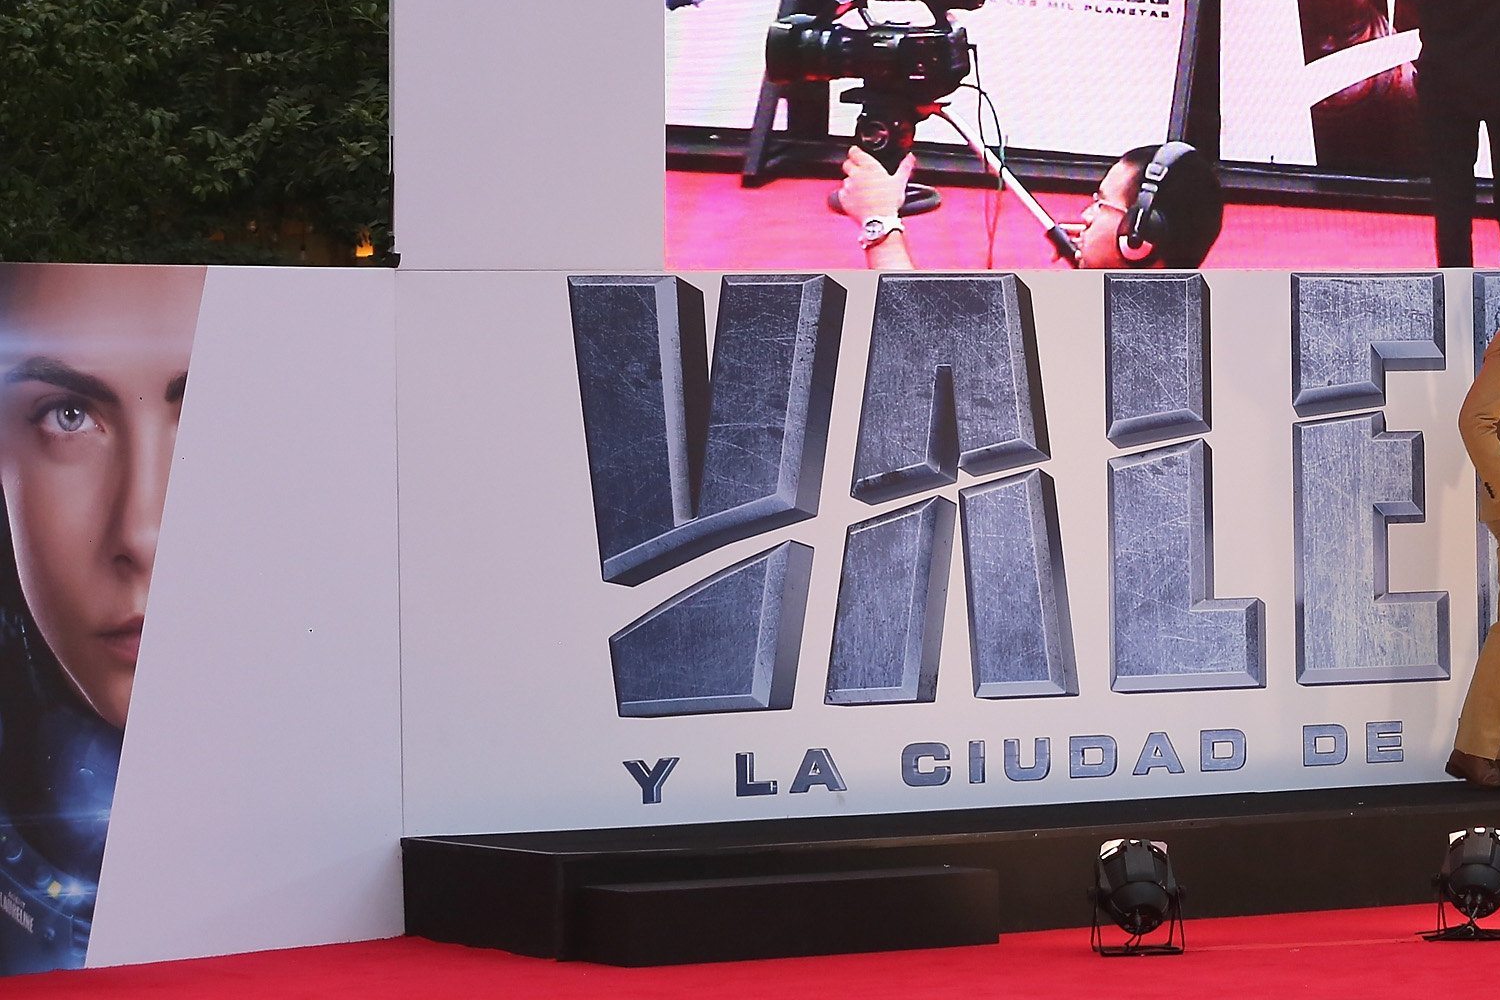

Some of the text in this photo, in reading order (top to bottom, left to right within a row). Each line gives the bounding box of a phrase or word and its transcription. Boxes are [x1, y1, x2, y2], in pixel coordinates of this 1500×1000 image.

[622, 757, 680, 804] Y
[735, 748, 848, 797] LA
[900, 728, 1247, 787] CIUDAD
[1303, 720, 1404, 768] DE
